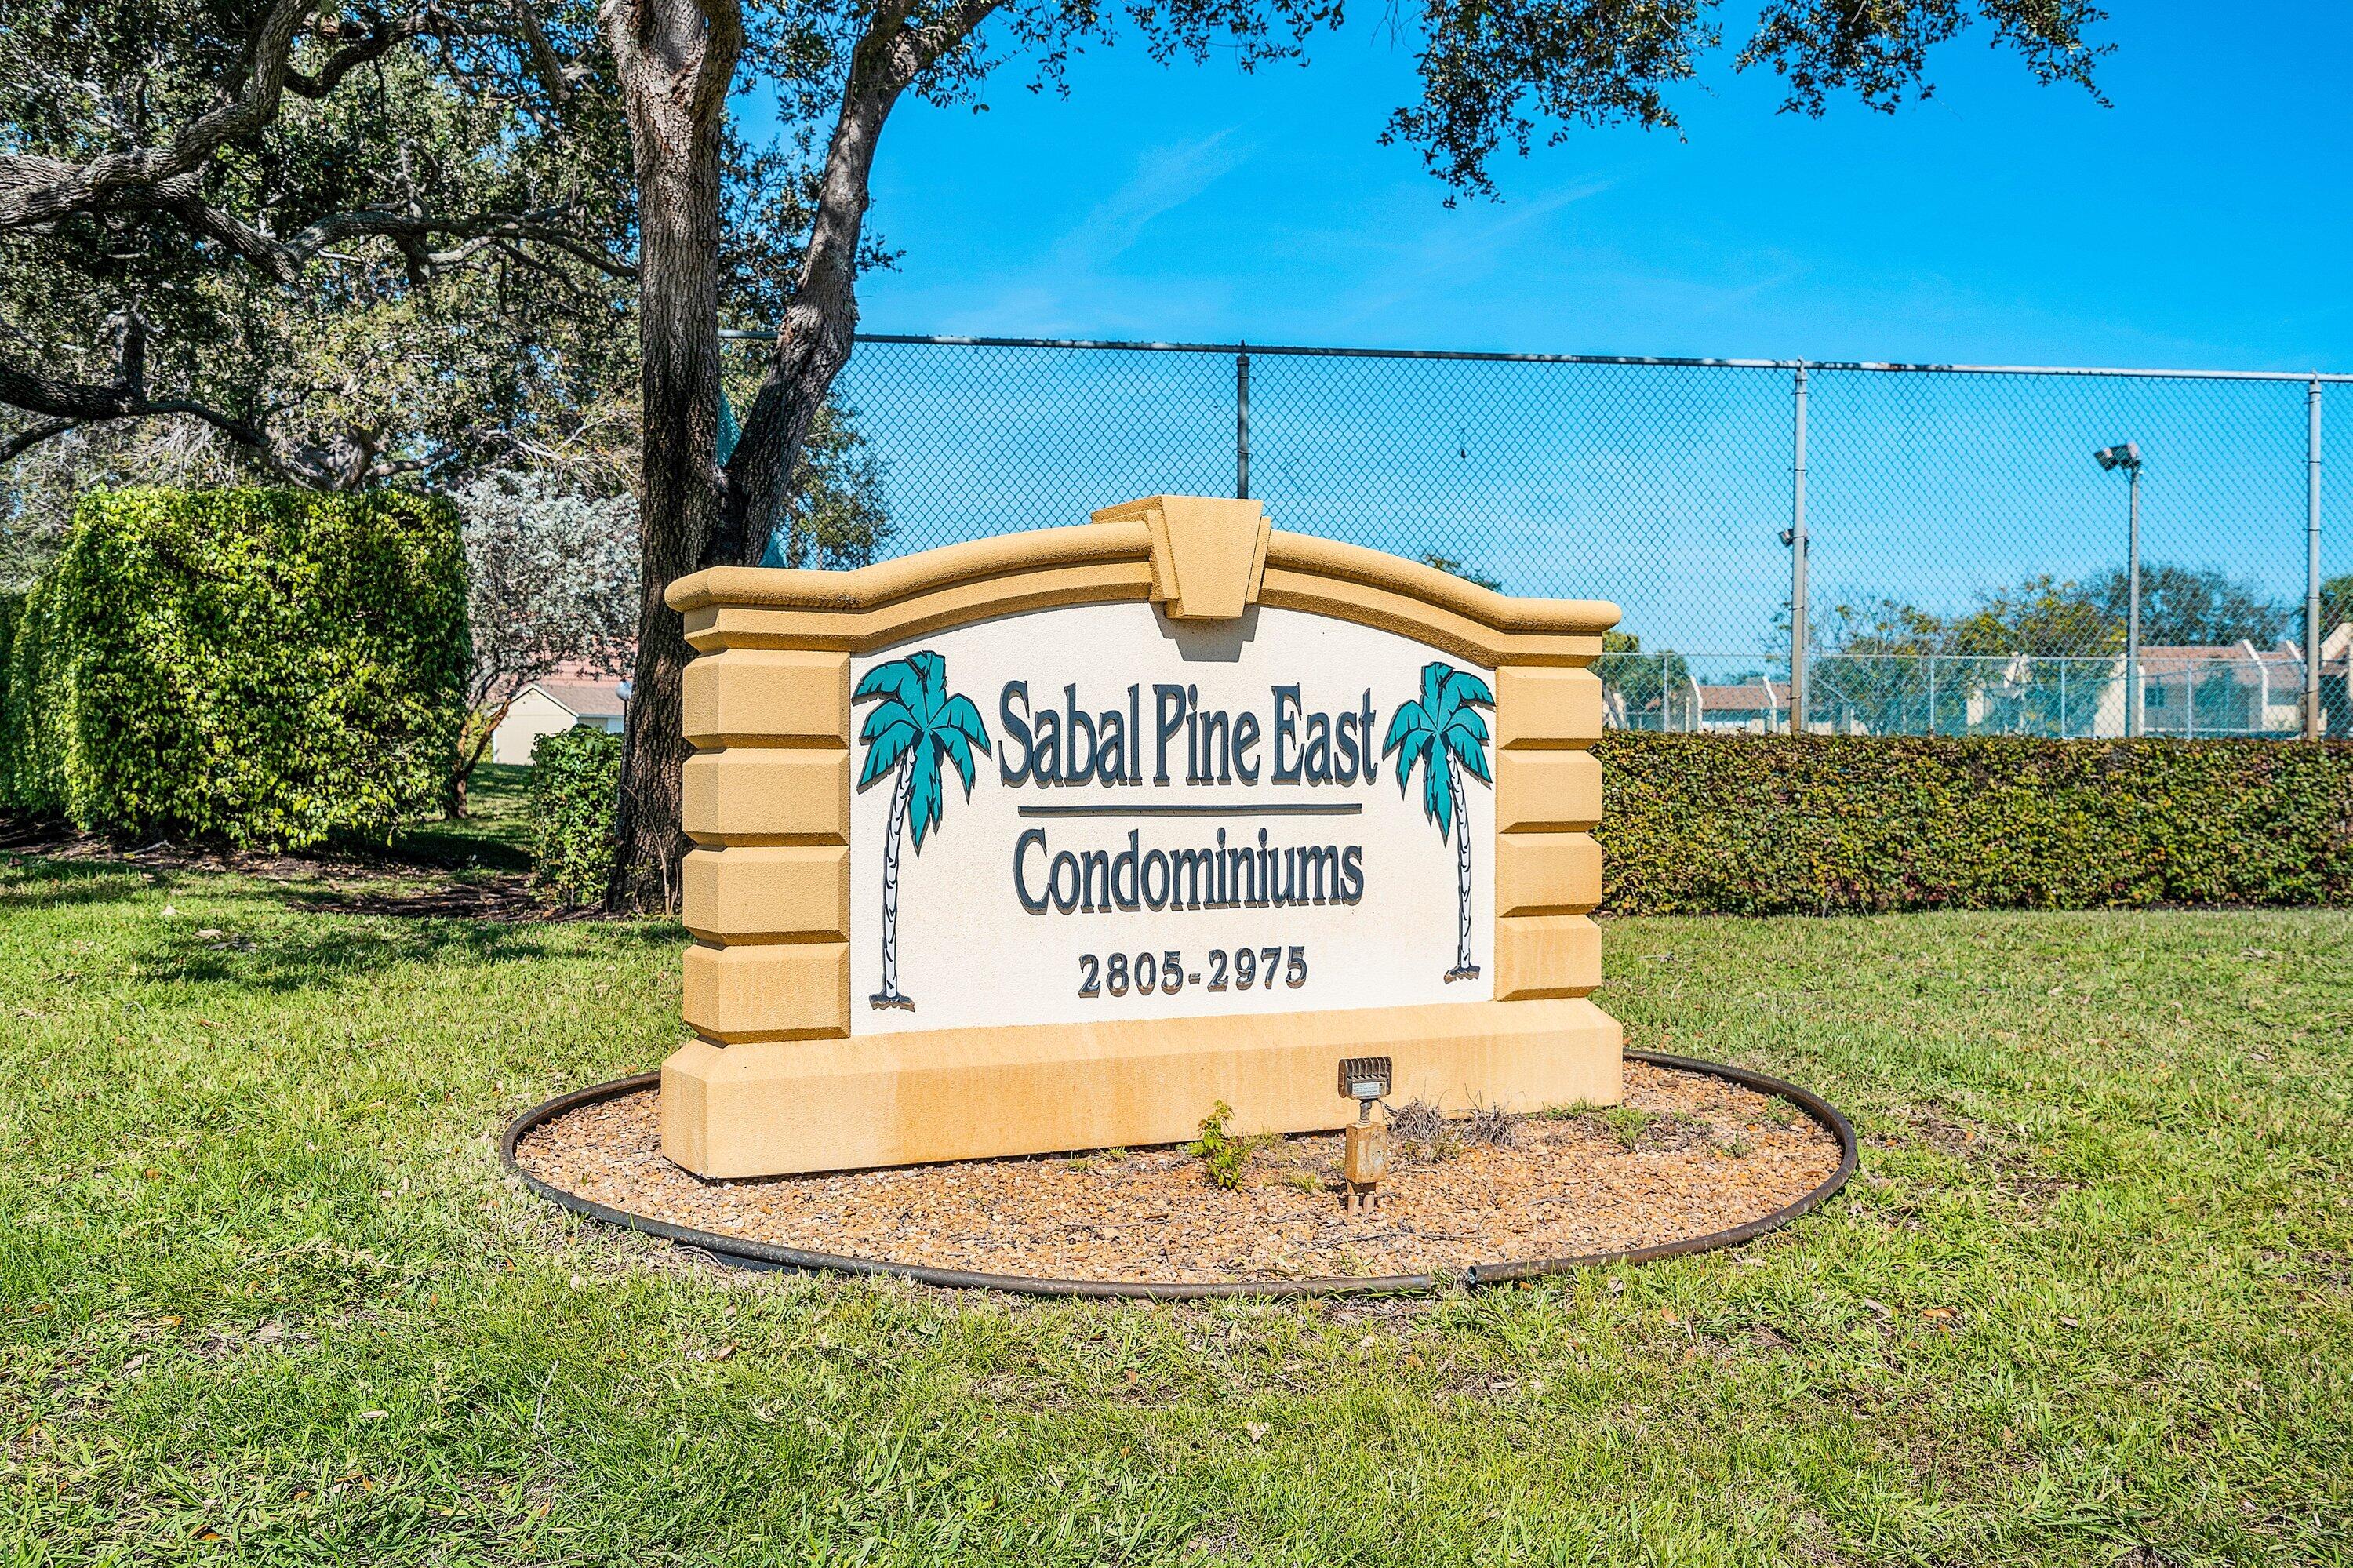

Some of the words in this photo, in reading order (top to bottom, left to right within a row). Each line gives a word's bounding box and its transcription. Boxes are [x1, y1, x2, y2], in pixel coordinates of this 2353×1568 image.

[998, 680, 1143, 789] Sabal
[1152, 683, 1261, 787] Pine
[1271, 682, 1378, 788] East
[1013, 827, 1364, 915] Condominiums
[1078, 945, 1308, 999] 2805-2975
